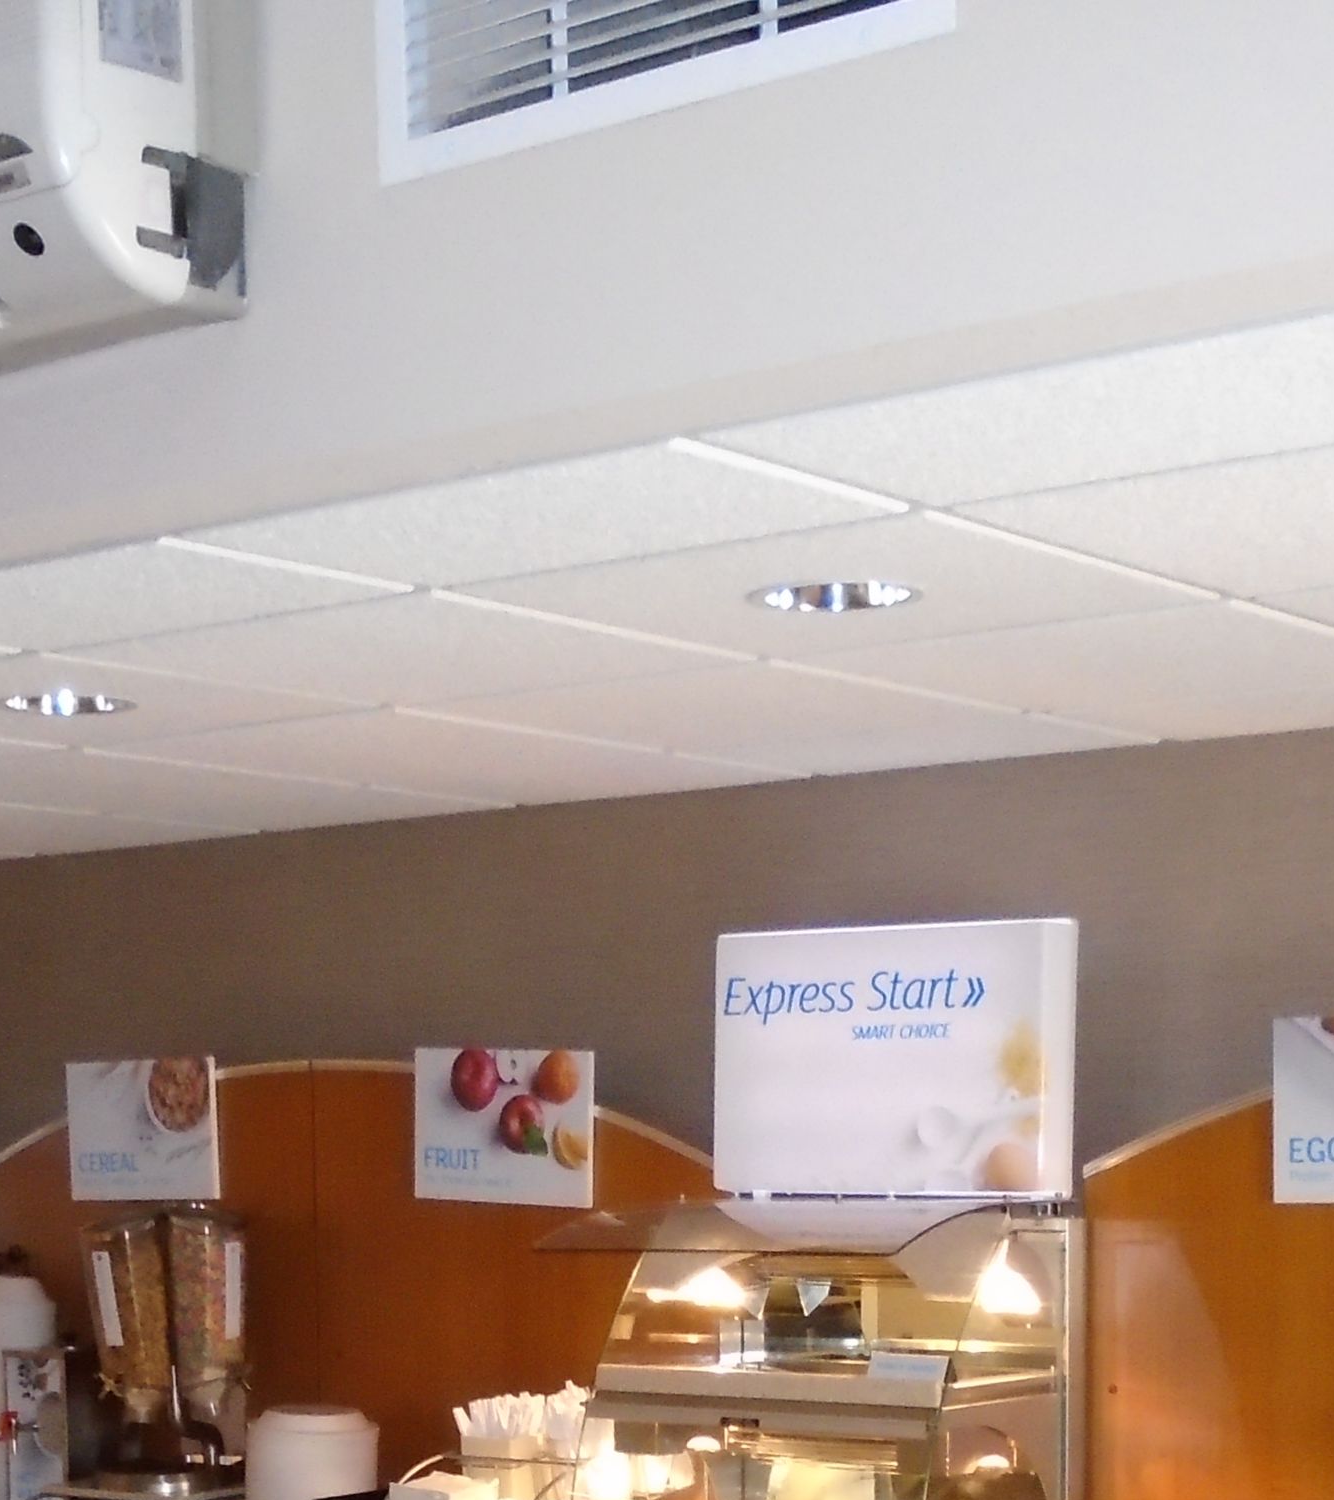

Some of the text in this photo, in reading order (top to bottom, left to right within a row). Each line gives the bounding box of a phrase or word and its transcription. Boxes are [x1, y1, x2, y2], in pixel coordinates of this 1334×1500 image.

[723, 977, 855, 1025] Express
[852, 1023, 950, 1040] SMART CHOICE
[78, 1151, 140, 1174] CEREAL
[423, 1147, 482, 1171] FRUIT
